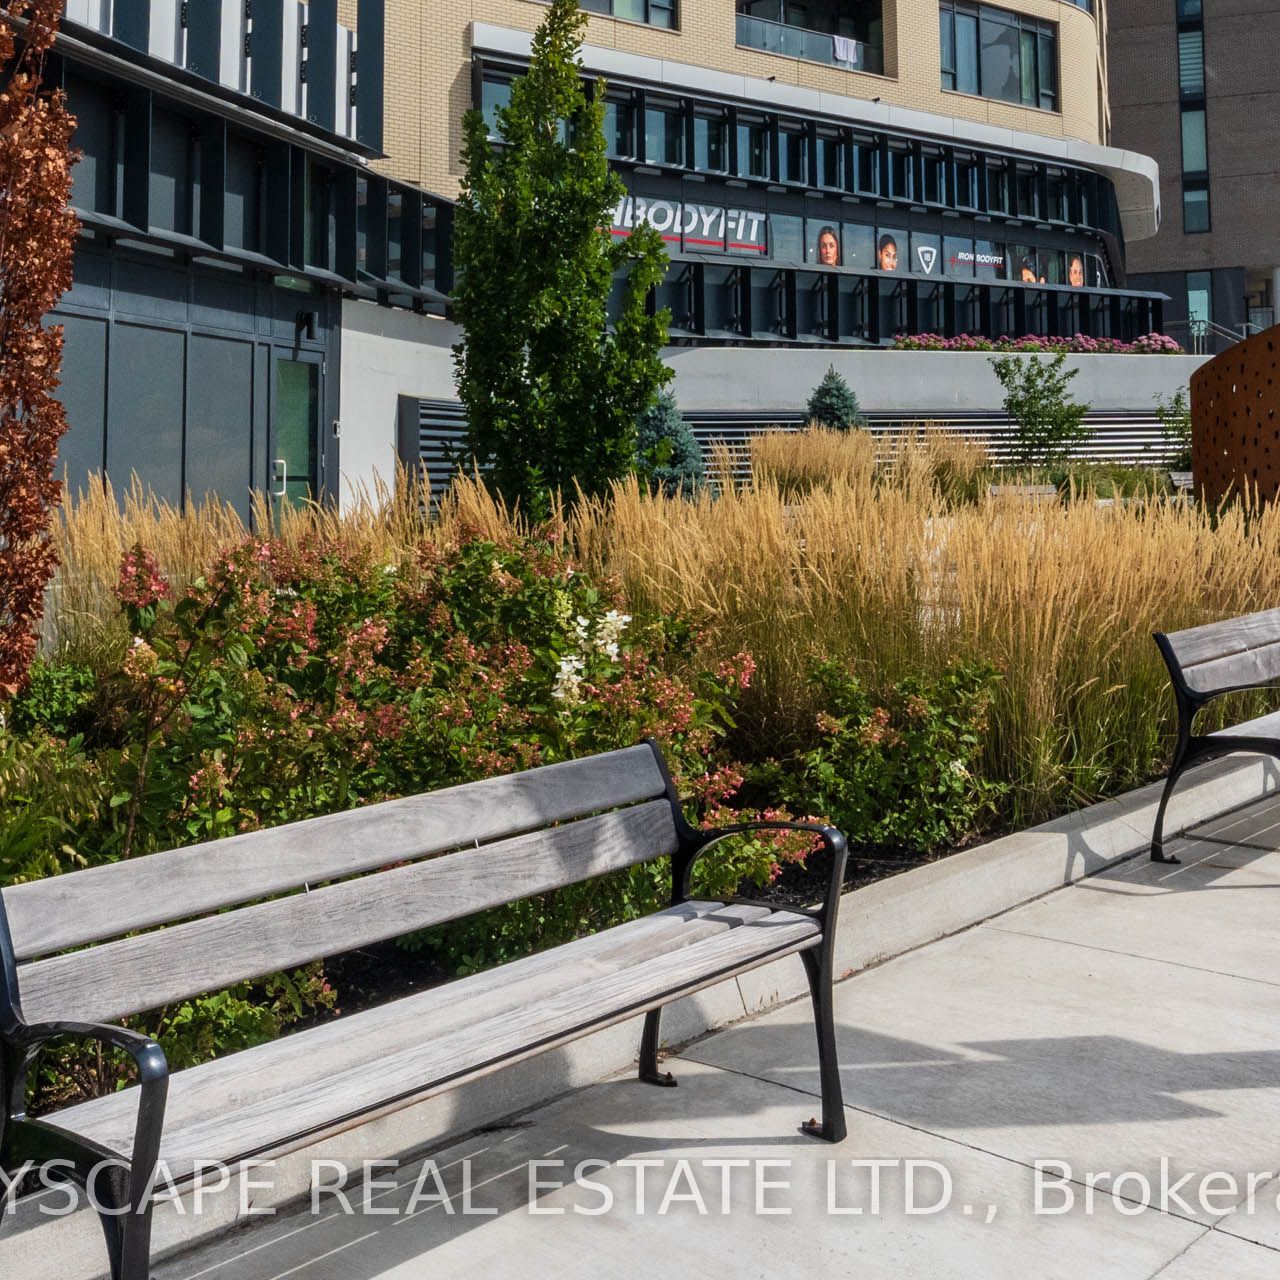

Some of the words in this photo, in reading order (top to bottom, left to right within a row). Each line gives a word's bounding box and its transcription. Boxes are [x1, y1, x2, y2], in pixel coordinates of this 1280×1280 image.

[624, 197, 766, 241] BODYFIT
[958, 252, 974, 260] IRON
[976, 254, 1003, 264] BODYFIT
